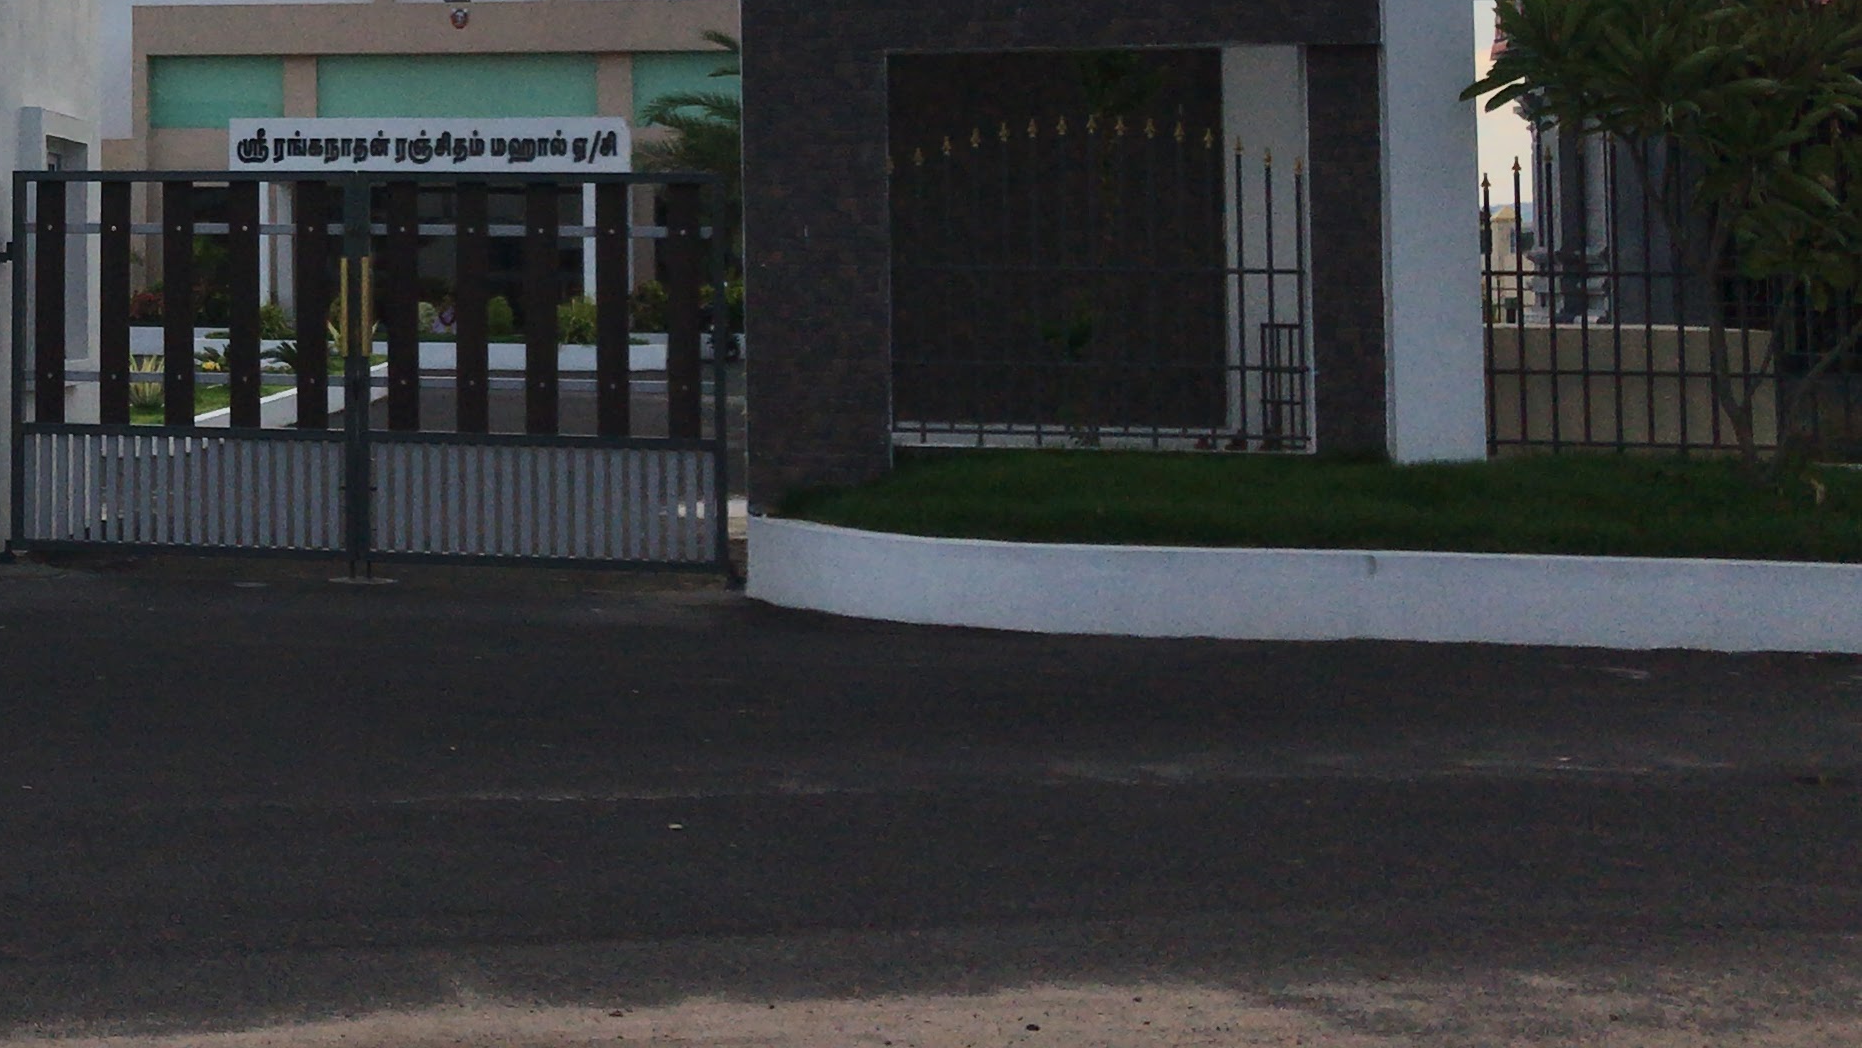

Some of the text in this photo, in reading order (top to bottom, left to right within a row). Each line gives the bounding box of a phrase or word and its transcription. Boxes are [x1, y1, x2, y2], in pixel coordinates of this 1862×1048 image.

[273, 129, 391, 164] ரங்கநாதன்
[394, 129, 485, 164] ரஞ்சிதம்
[490, 129, 567, 164] மஹால்
